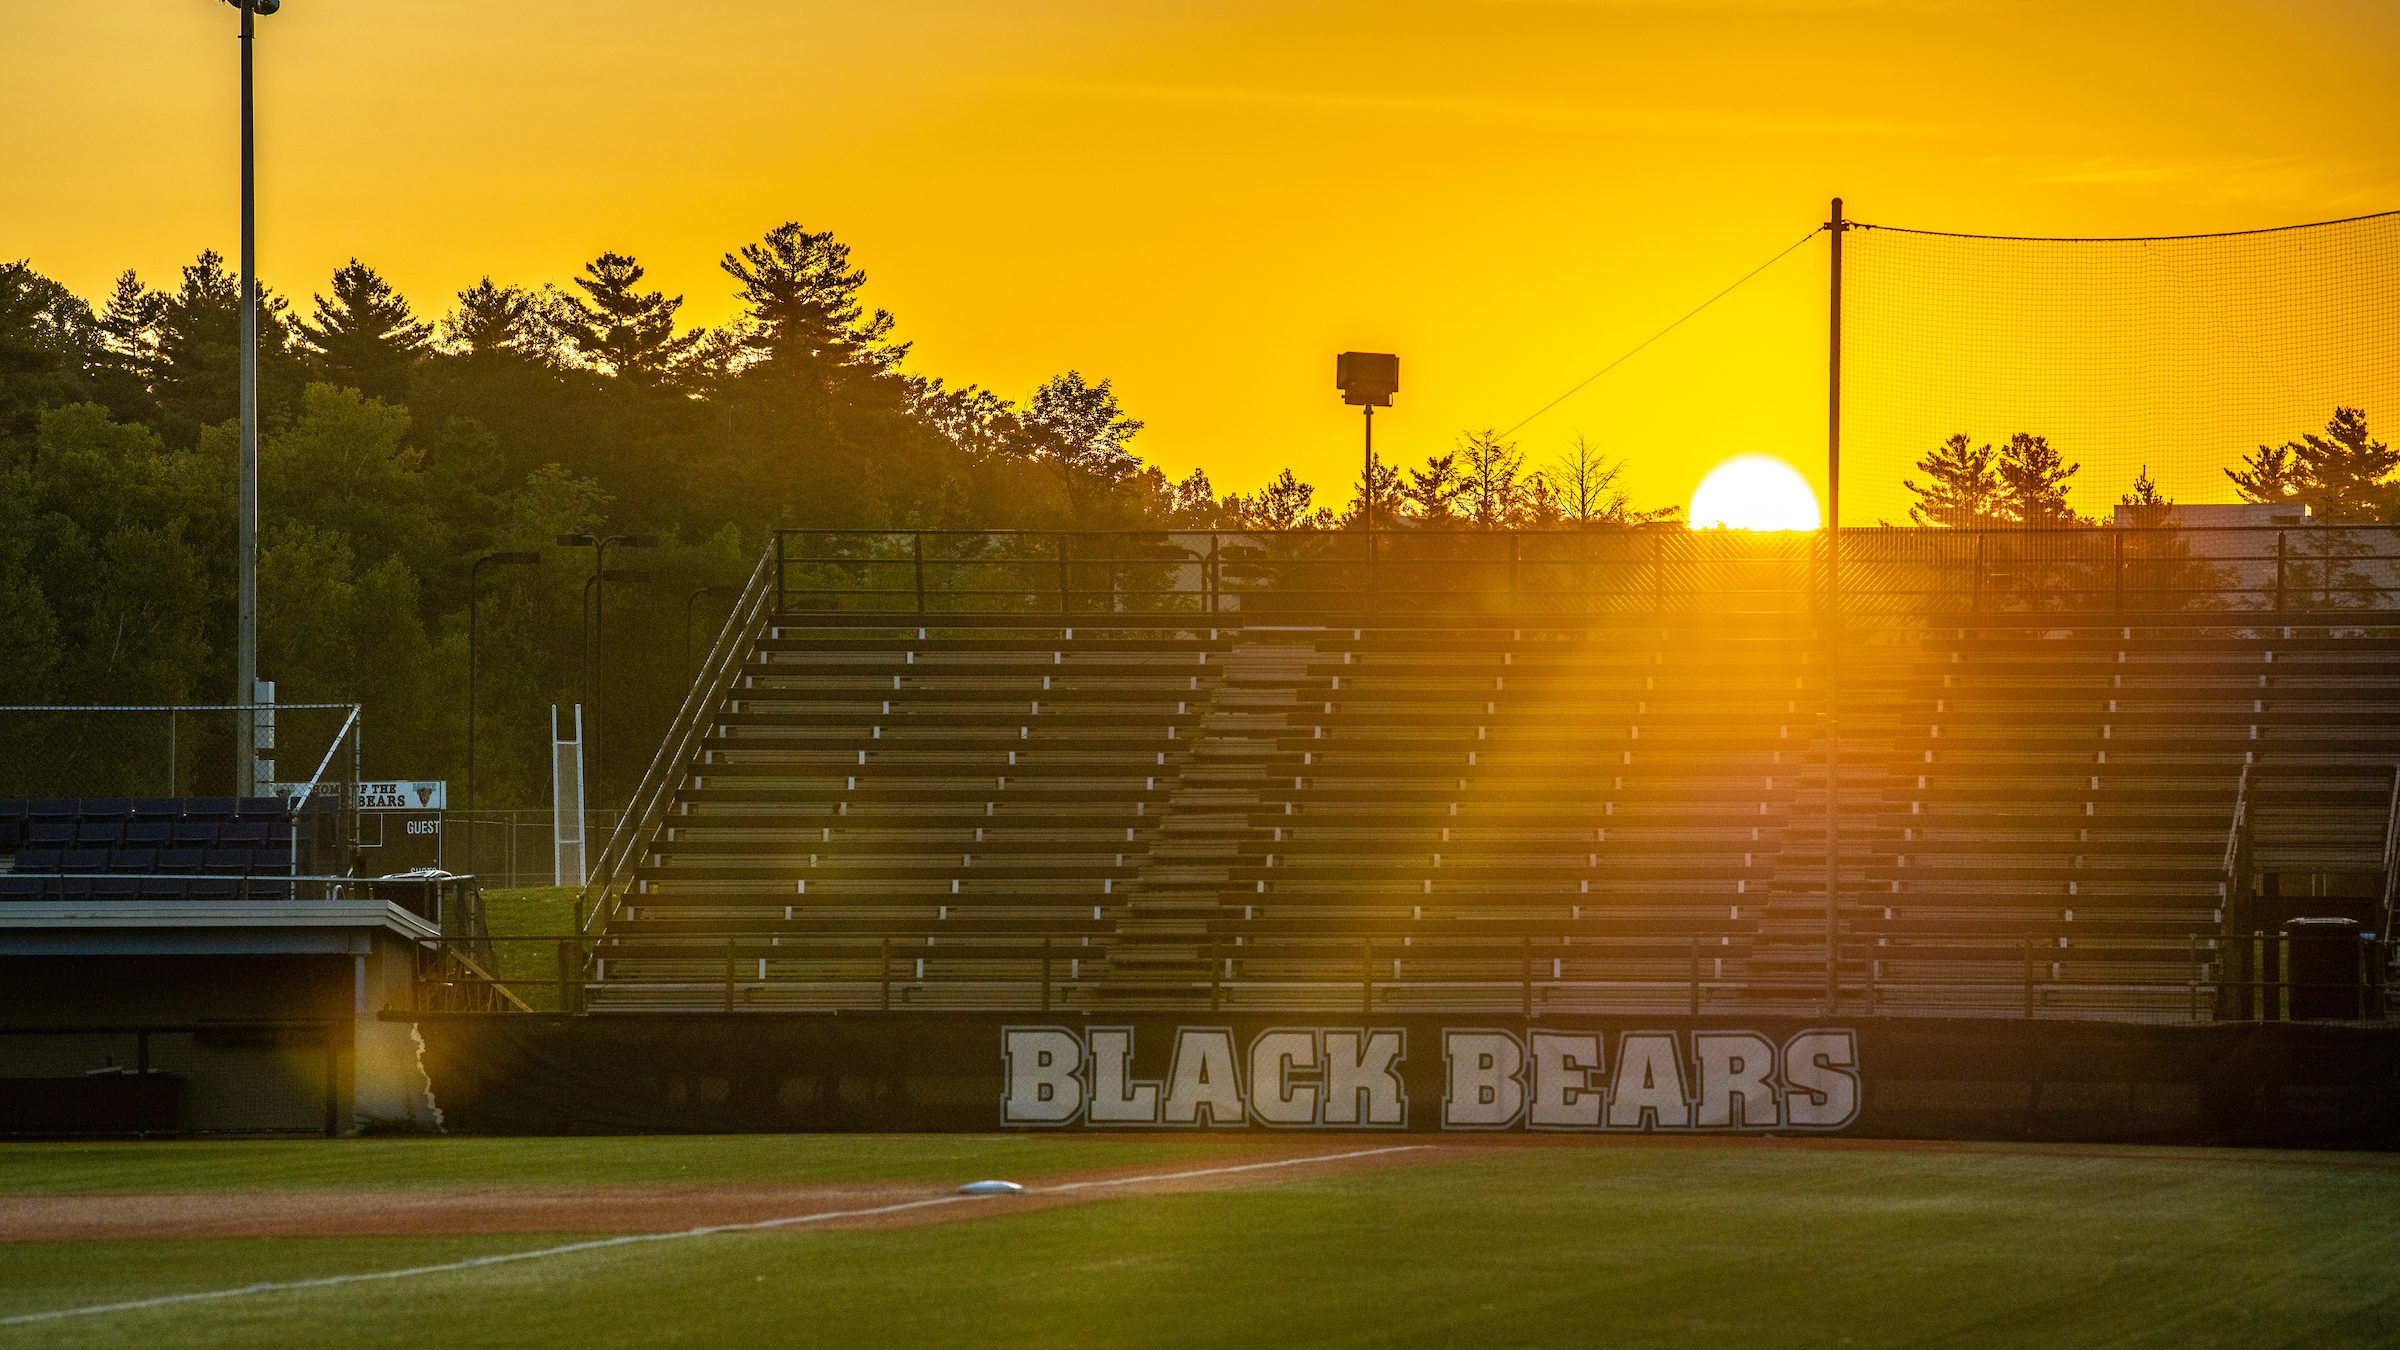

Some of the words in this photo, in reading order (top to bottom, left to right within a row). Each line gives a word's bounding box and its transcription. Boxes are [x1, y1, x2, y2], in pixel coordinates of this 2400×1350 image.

[371, 784, 397, 794] THE
[358, 795, 406, 808] BEARS
[406, 820, 440, 835] GUEST
[1001, 1025, 1408, 1128] BLACK
[1442, 1027, 1862, 1132] BEARS
